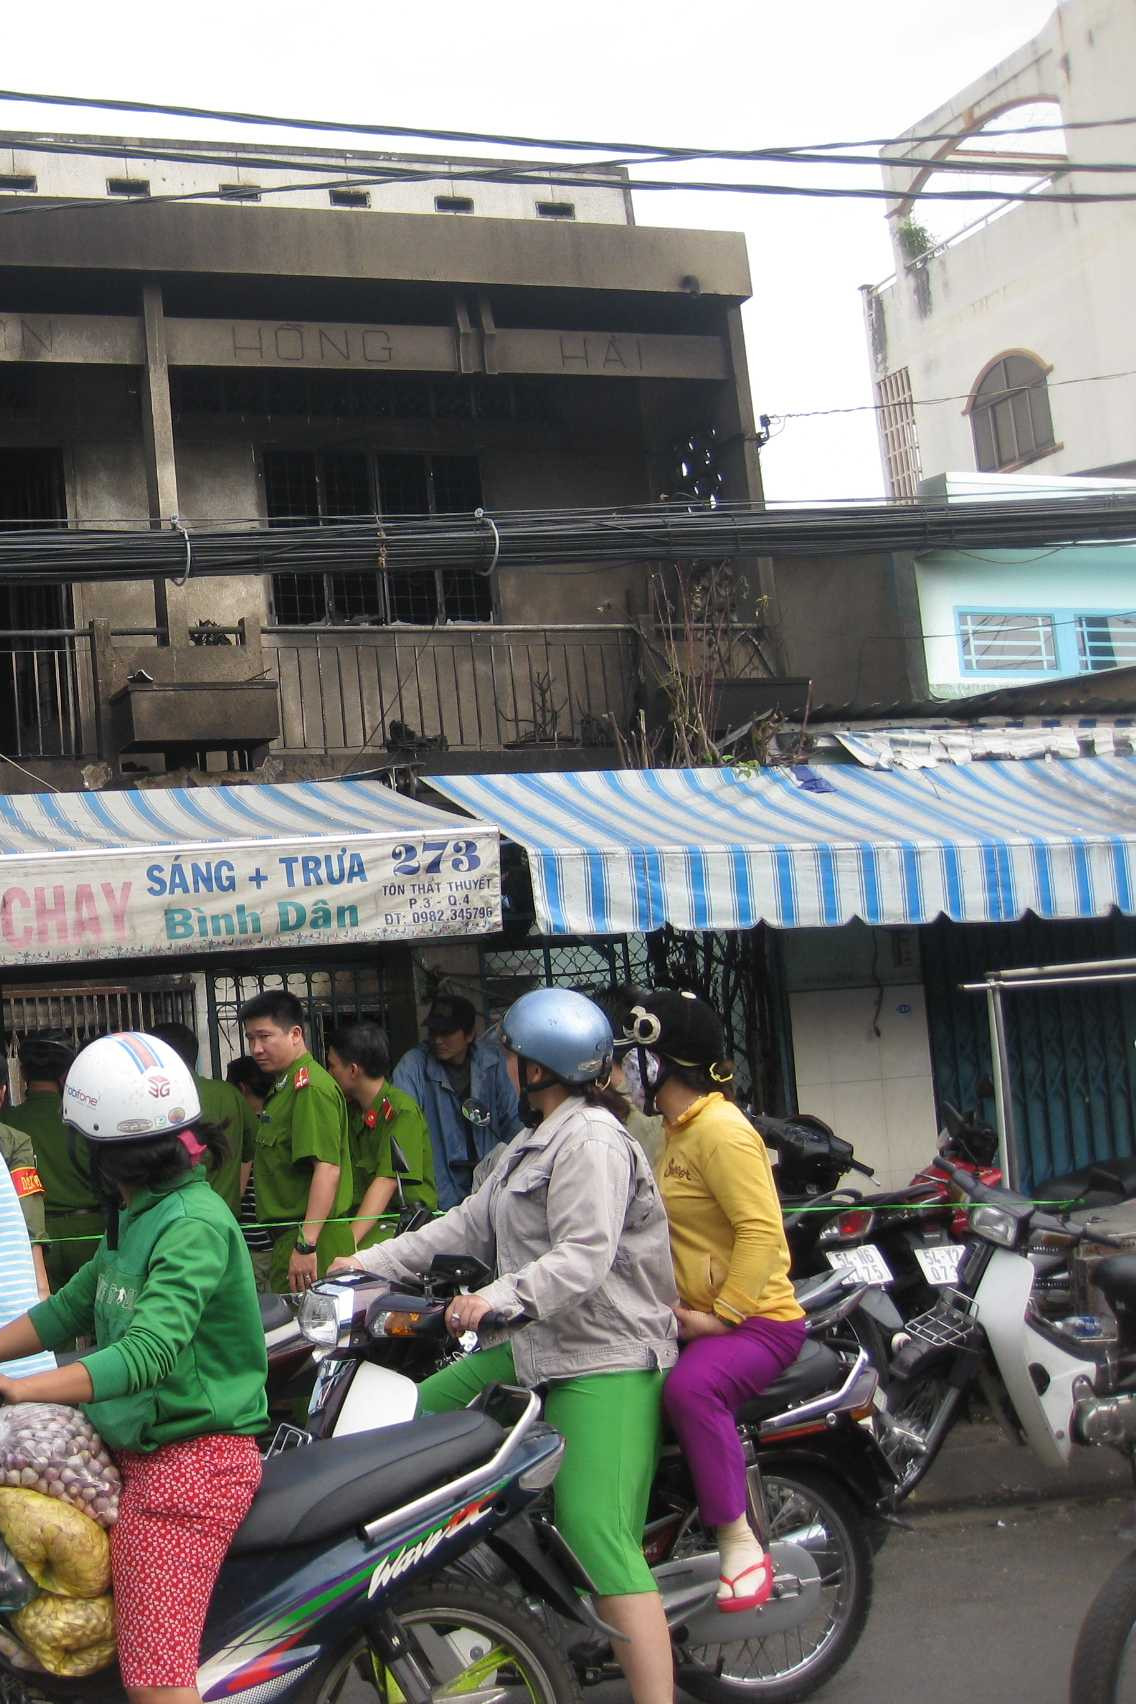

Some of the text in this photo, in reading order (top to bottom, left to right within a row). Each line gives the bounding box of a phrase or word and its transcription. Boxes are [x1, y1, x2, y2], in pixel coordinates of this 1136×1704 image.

[146, 854, 236, 897] SÁNG
[278, 847, 368, 888] TRƯA
[390, 840, 482, 876] 273
[0, 880, 134, 950] CHAY
[164, 898, 360, 940] Bình Dân
